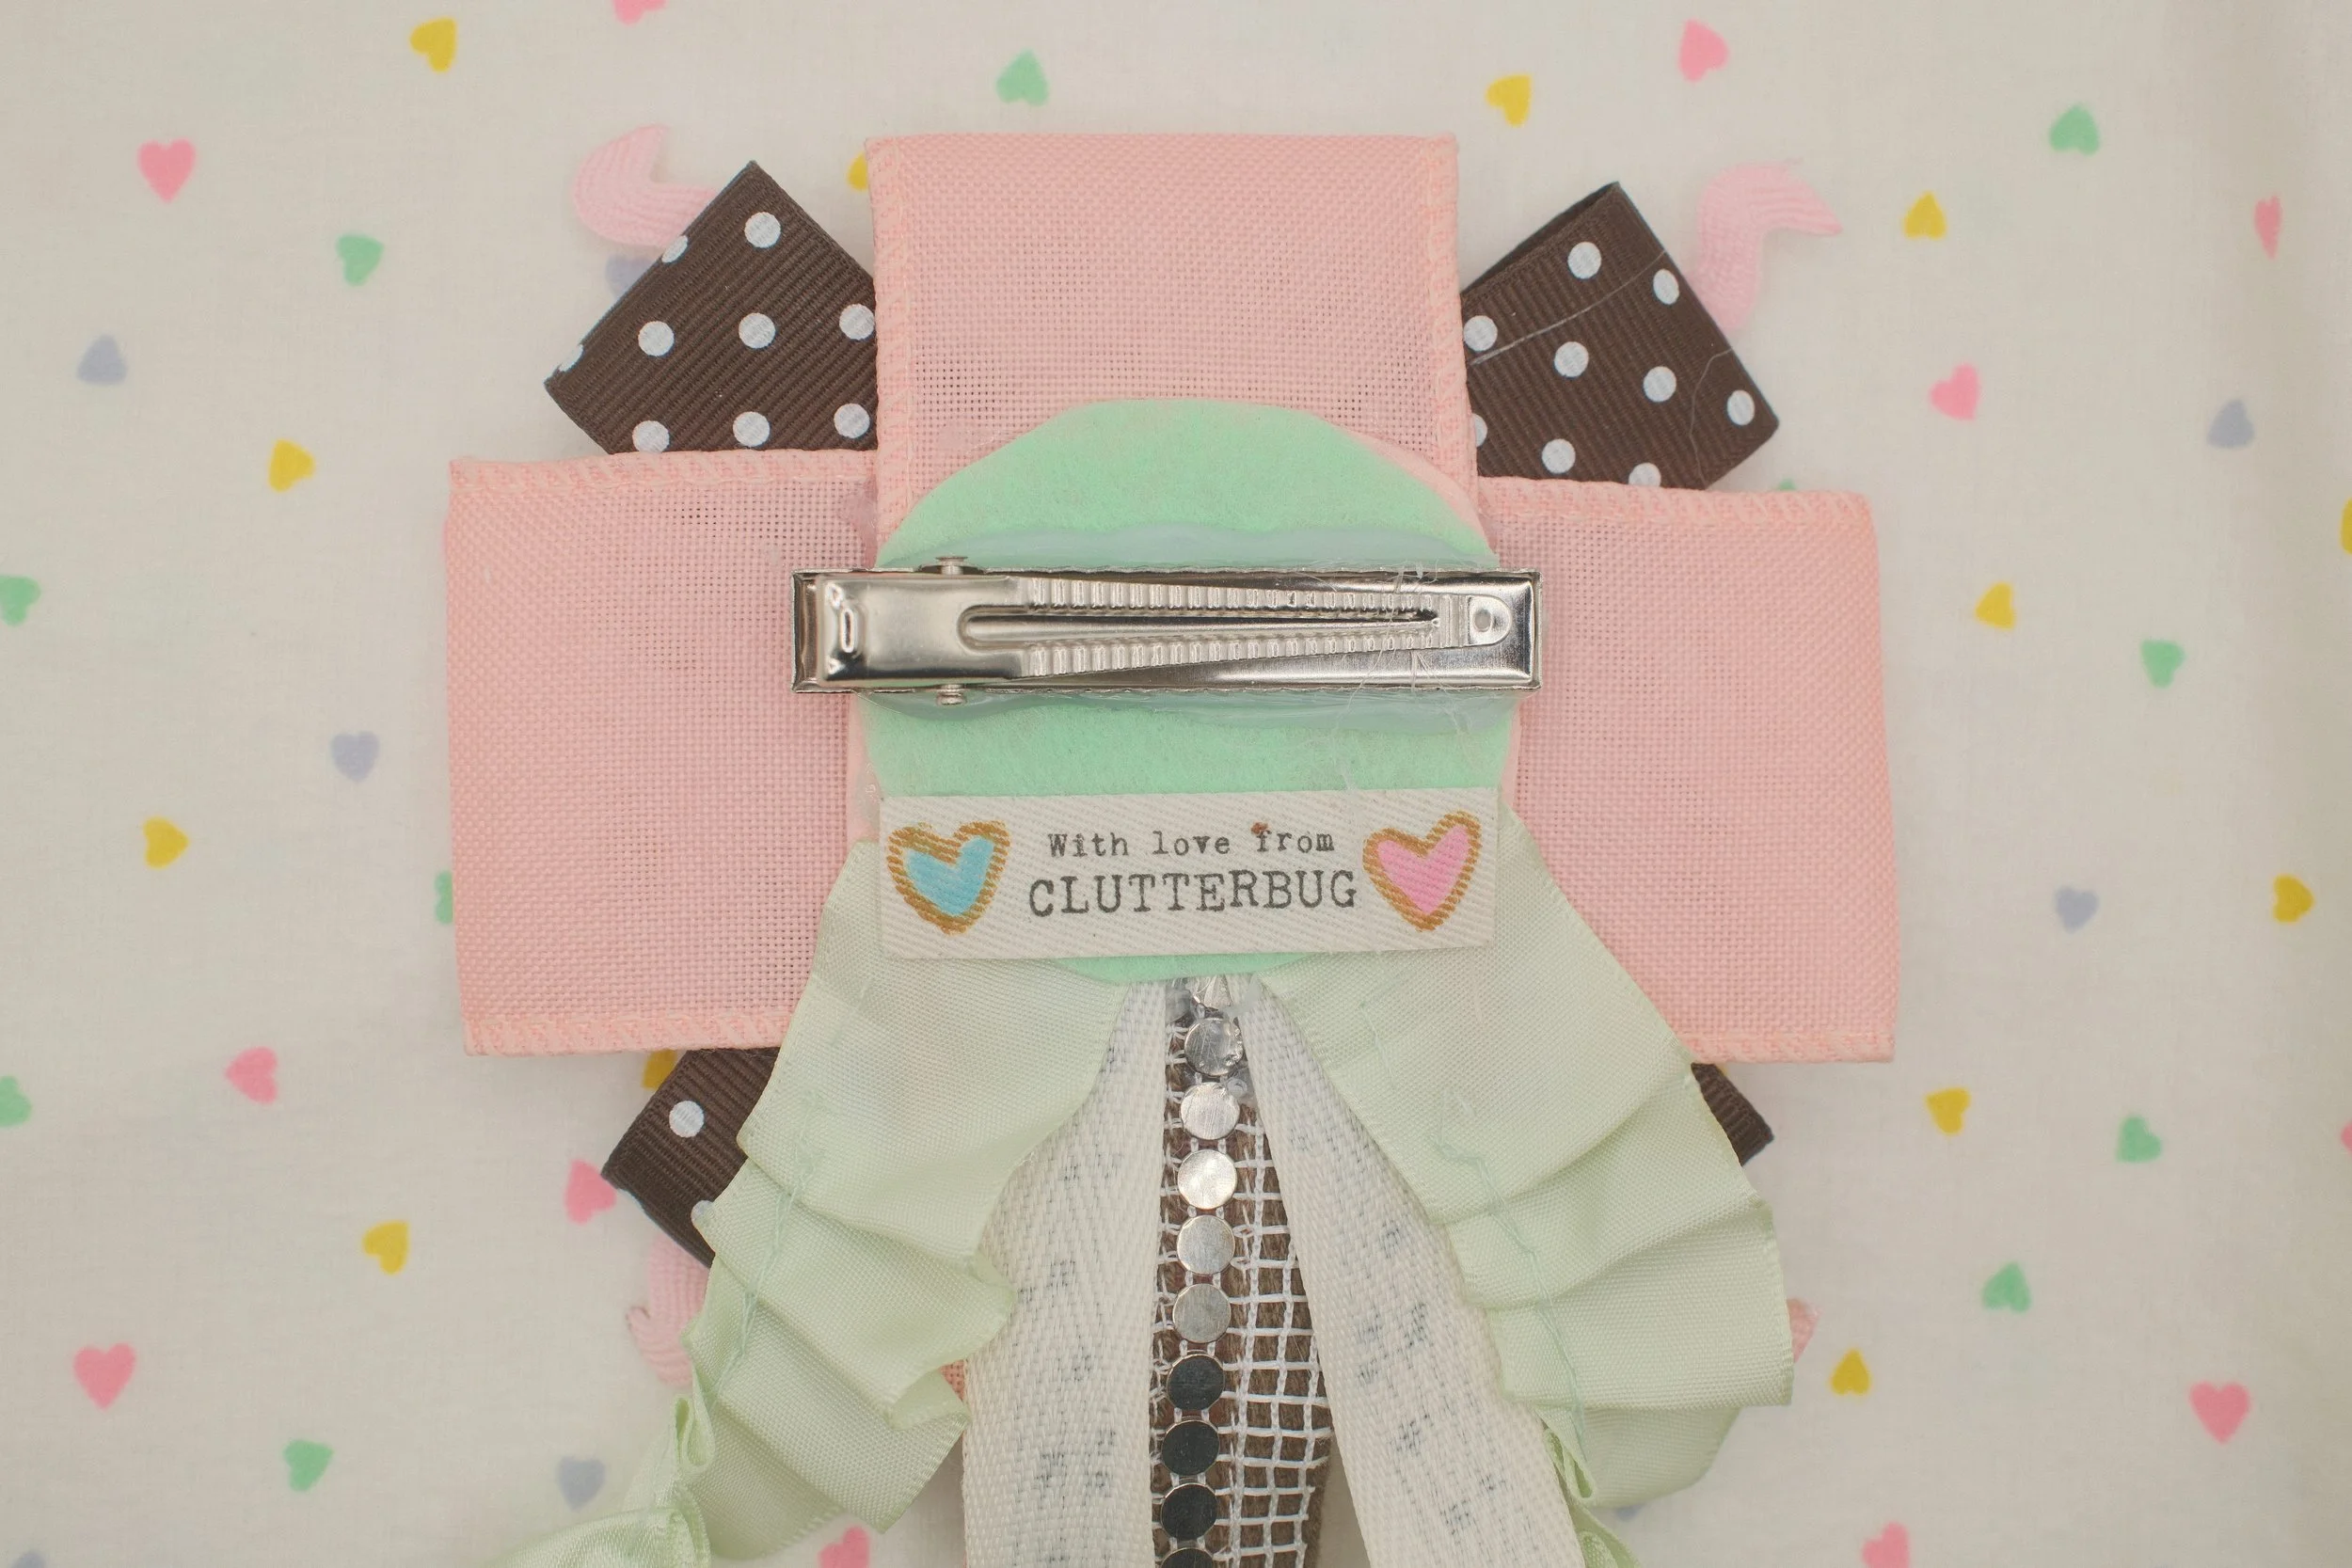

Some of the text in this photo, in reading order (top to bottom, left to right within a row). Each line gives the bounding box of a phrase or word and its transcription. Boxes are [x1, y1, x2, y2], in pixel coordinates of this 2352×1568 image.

[1048, 829, 1335, 858] With love from
[1028, 869, 1358, 917] CLUTTERBUG
